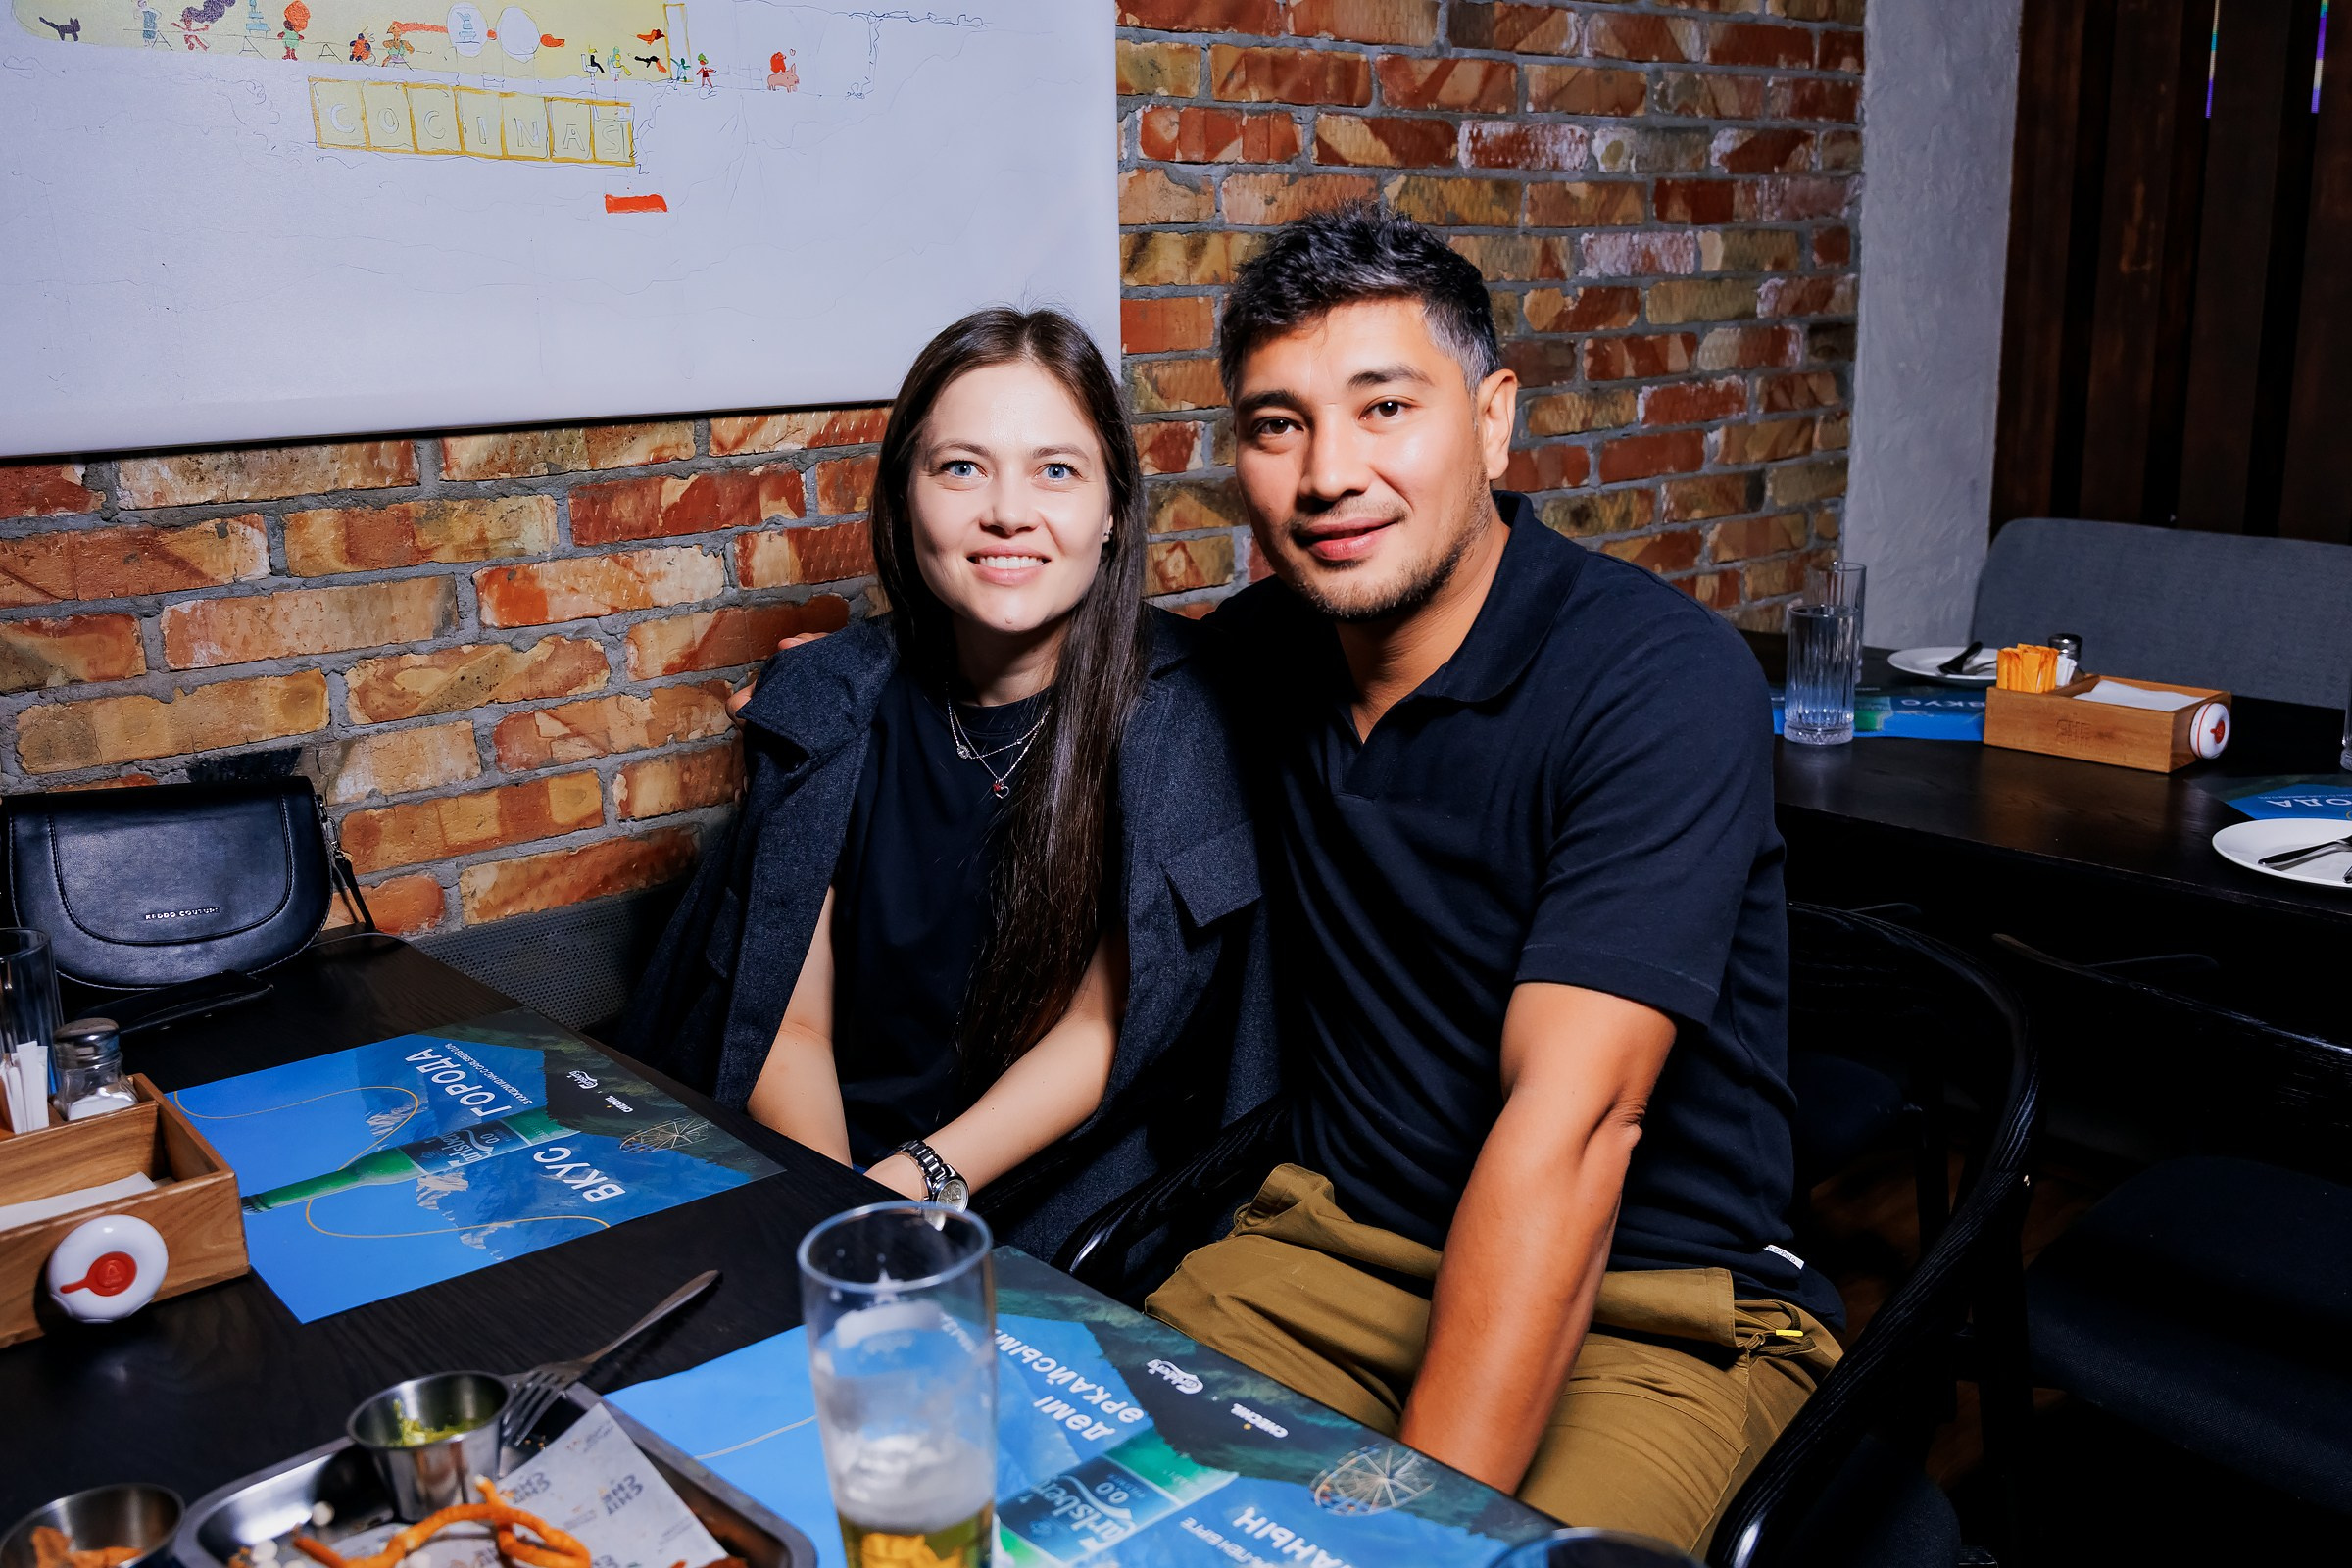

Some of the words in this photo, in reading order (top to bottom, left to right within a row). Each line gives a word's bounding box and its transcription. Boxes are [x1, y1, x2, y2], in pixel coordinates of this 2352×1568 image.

[329, 102, 622, 154] COCINAS
[405, 1048, 512, 1117] ГОРОДА
[533, 1147, 626, 1202] ВКУС
[995, 1328, 1145, 1423] ӘРҚАЙСЫМ
[1033, 1395, 1116, 1441] ДӘМІ
[1094, 1481, 1129, 1504] 0.0
[1232, 1506, 1356, 1568] АНЫҢ
